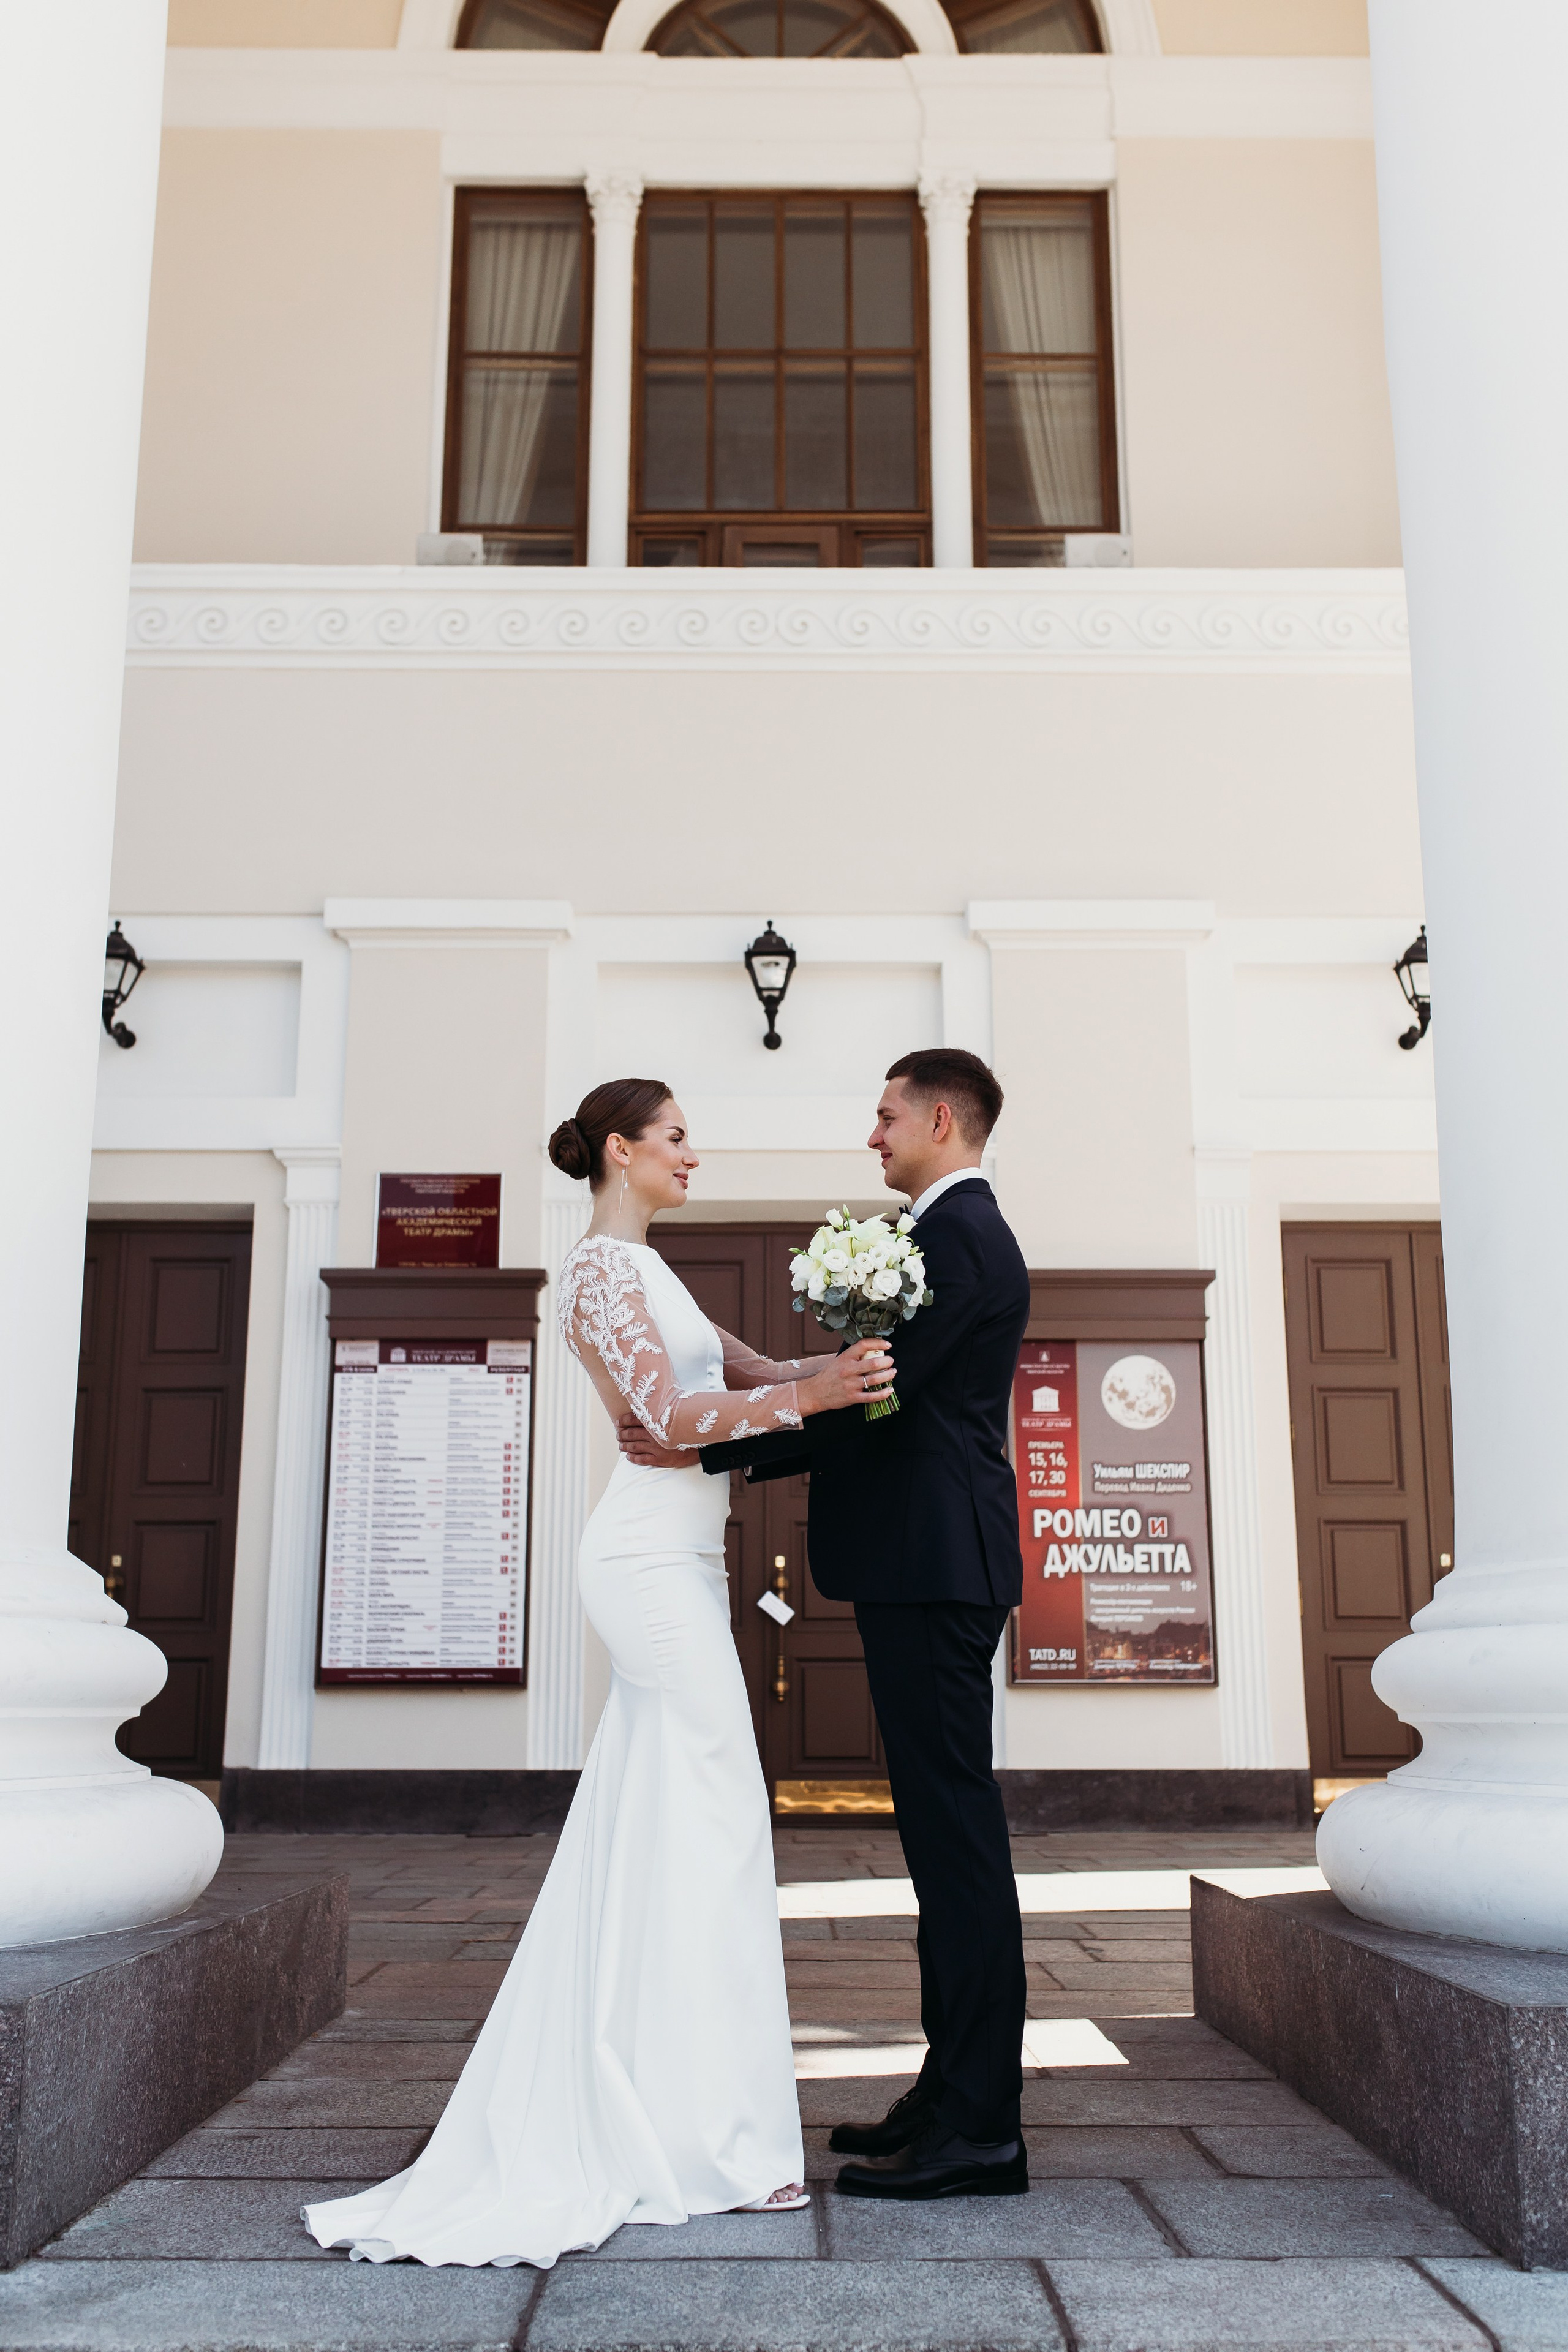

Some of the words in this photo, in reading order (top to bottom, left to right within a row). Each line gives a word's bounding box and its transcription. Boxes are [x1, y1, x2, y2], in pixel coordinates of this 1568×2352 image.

[437, 1207, 497, 1216] ОБЛАСТНОЙ
[396, 1217, 482, 1226] АКАДЕМИЧЕСКИЙ
[404, 1227, 432, 1237] ТЕАТР
[1028, 1441, 1065, 1449] ПРЕМЬЕРА
[1028, 1452, 1047, 1468] 15,
[1049, 1452, 1068, 1468] 16,
[1049, 1470, 1066, 1485] 30
[1093, 1463, 1134, 1478] Уильям
[1135, 1463, 1191, 1479] ШЕКСПИР
[1028, 1489, 1067, 1498] СЕНТЯБРЯ
[1033, 1509, 1142, 1538] РОМЕО
[1043, 1544, 1192, 1578] ДЖУЛЬЕТТА
[1028, 1648, 1076, 1661] TATD.RU
